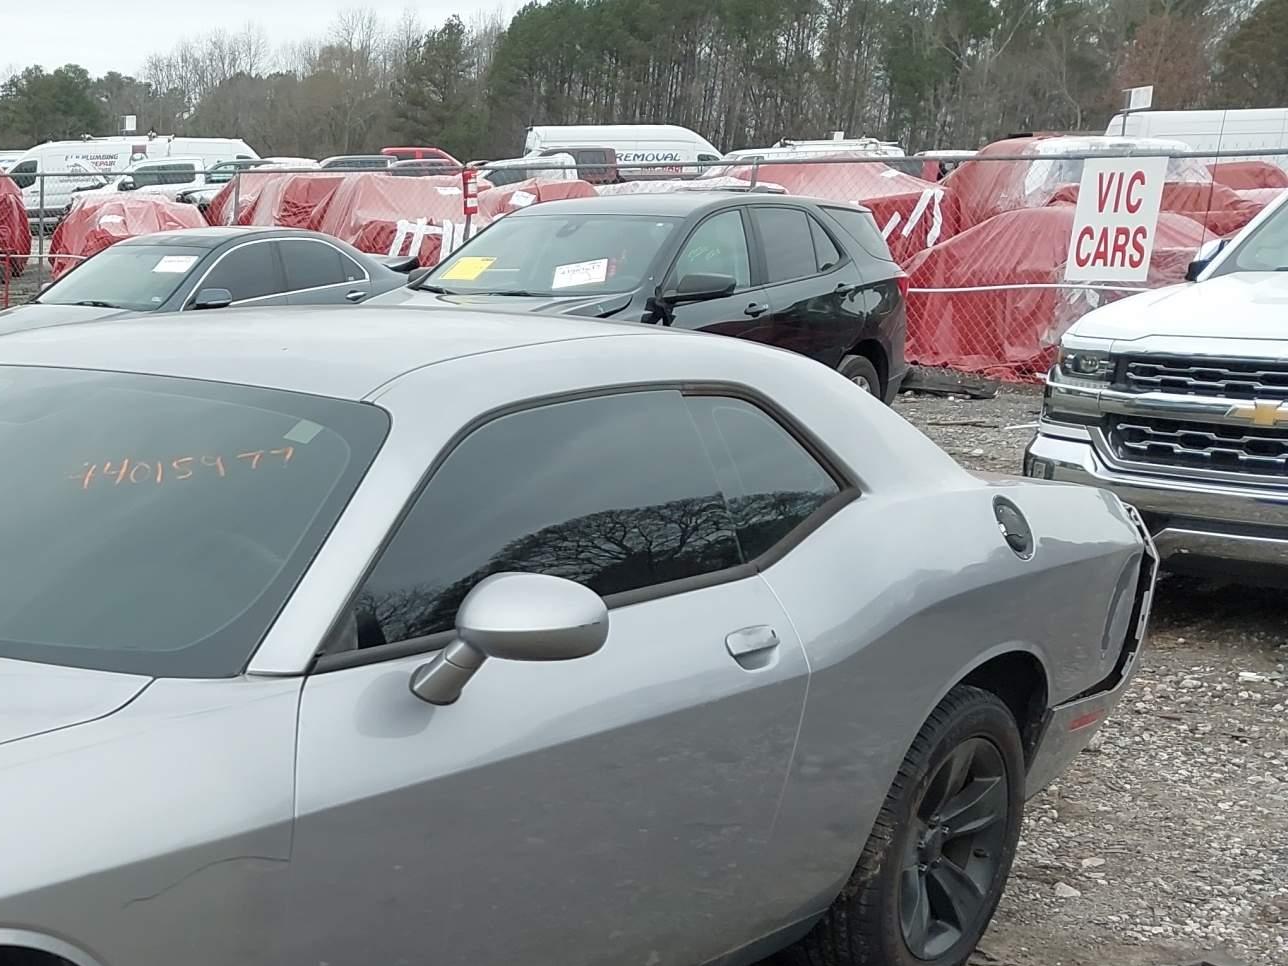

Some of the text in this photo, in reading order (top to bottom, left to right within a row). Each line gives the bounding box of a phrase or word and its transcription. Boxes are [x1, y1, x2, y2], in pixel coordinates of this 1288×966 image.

[616, 153, 681, 162] REMOVAL
[1098, 171, 1146, 214] VIC
[1075, 226, 1148, 269] CARS
